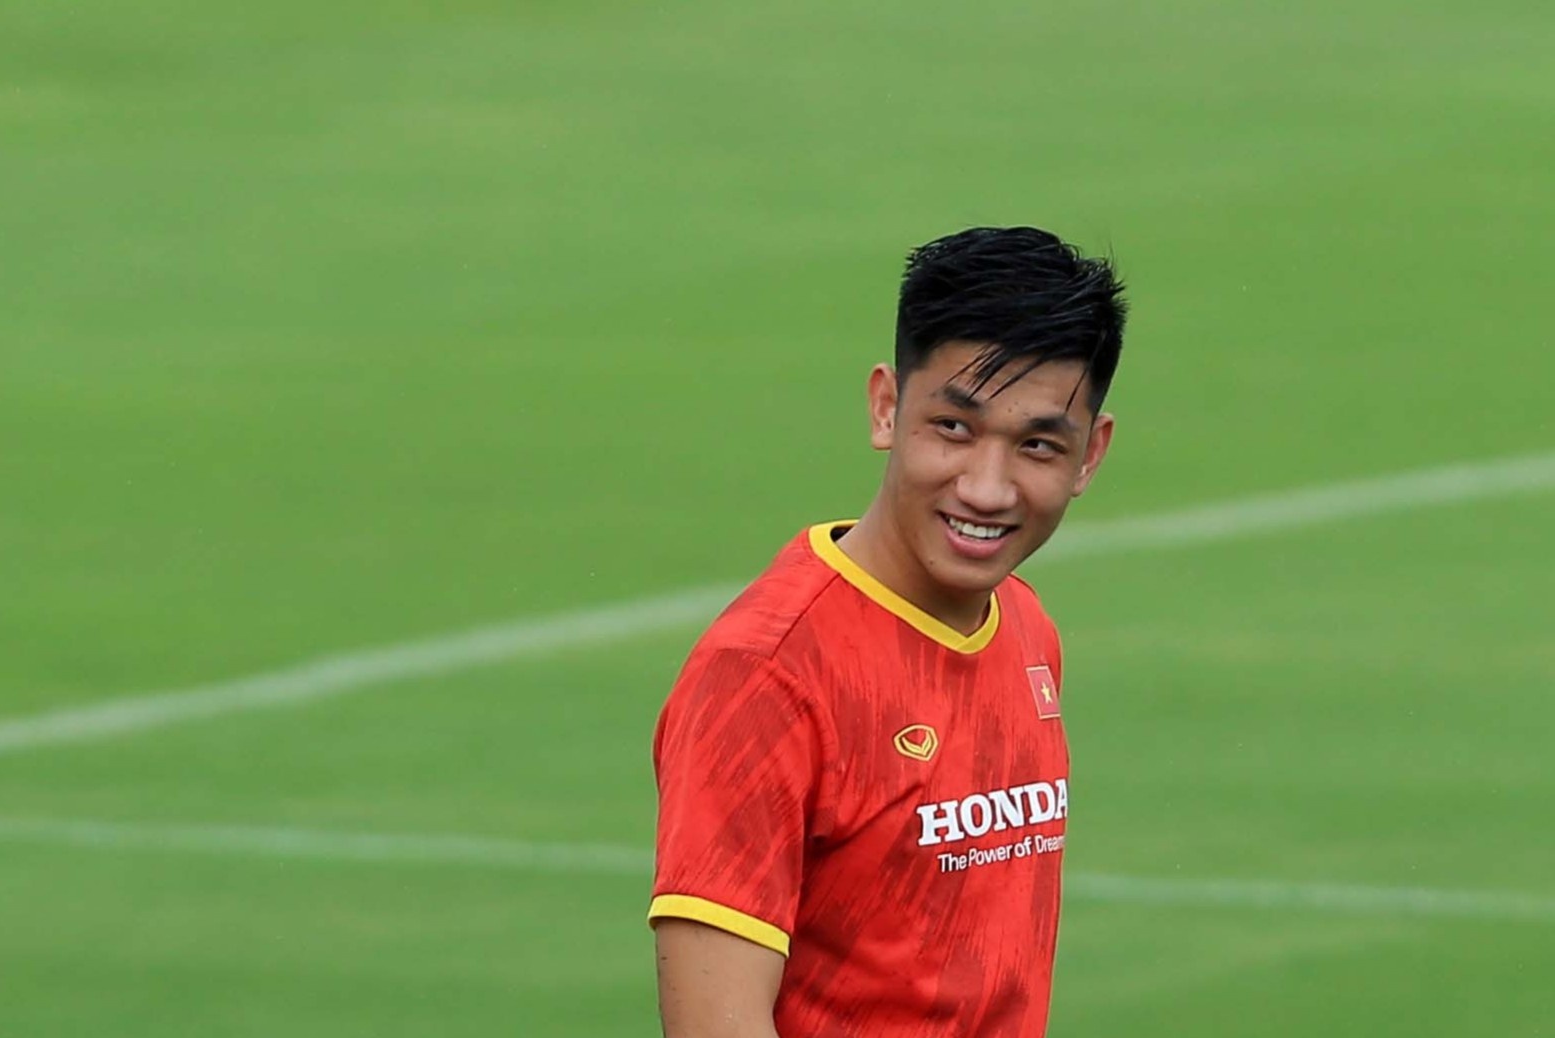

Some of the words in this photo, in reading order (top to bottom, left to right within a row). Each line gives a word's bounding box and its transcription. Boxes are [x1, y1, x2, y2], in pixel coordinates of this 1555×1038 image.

[916, 779, 1068, 846] HONDA
[937, 853, 966, 873] The
[968, 845, 1013, 867] Power
[1014, 836, 1032, 857] of
